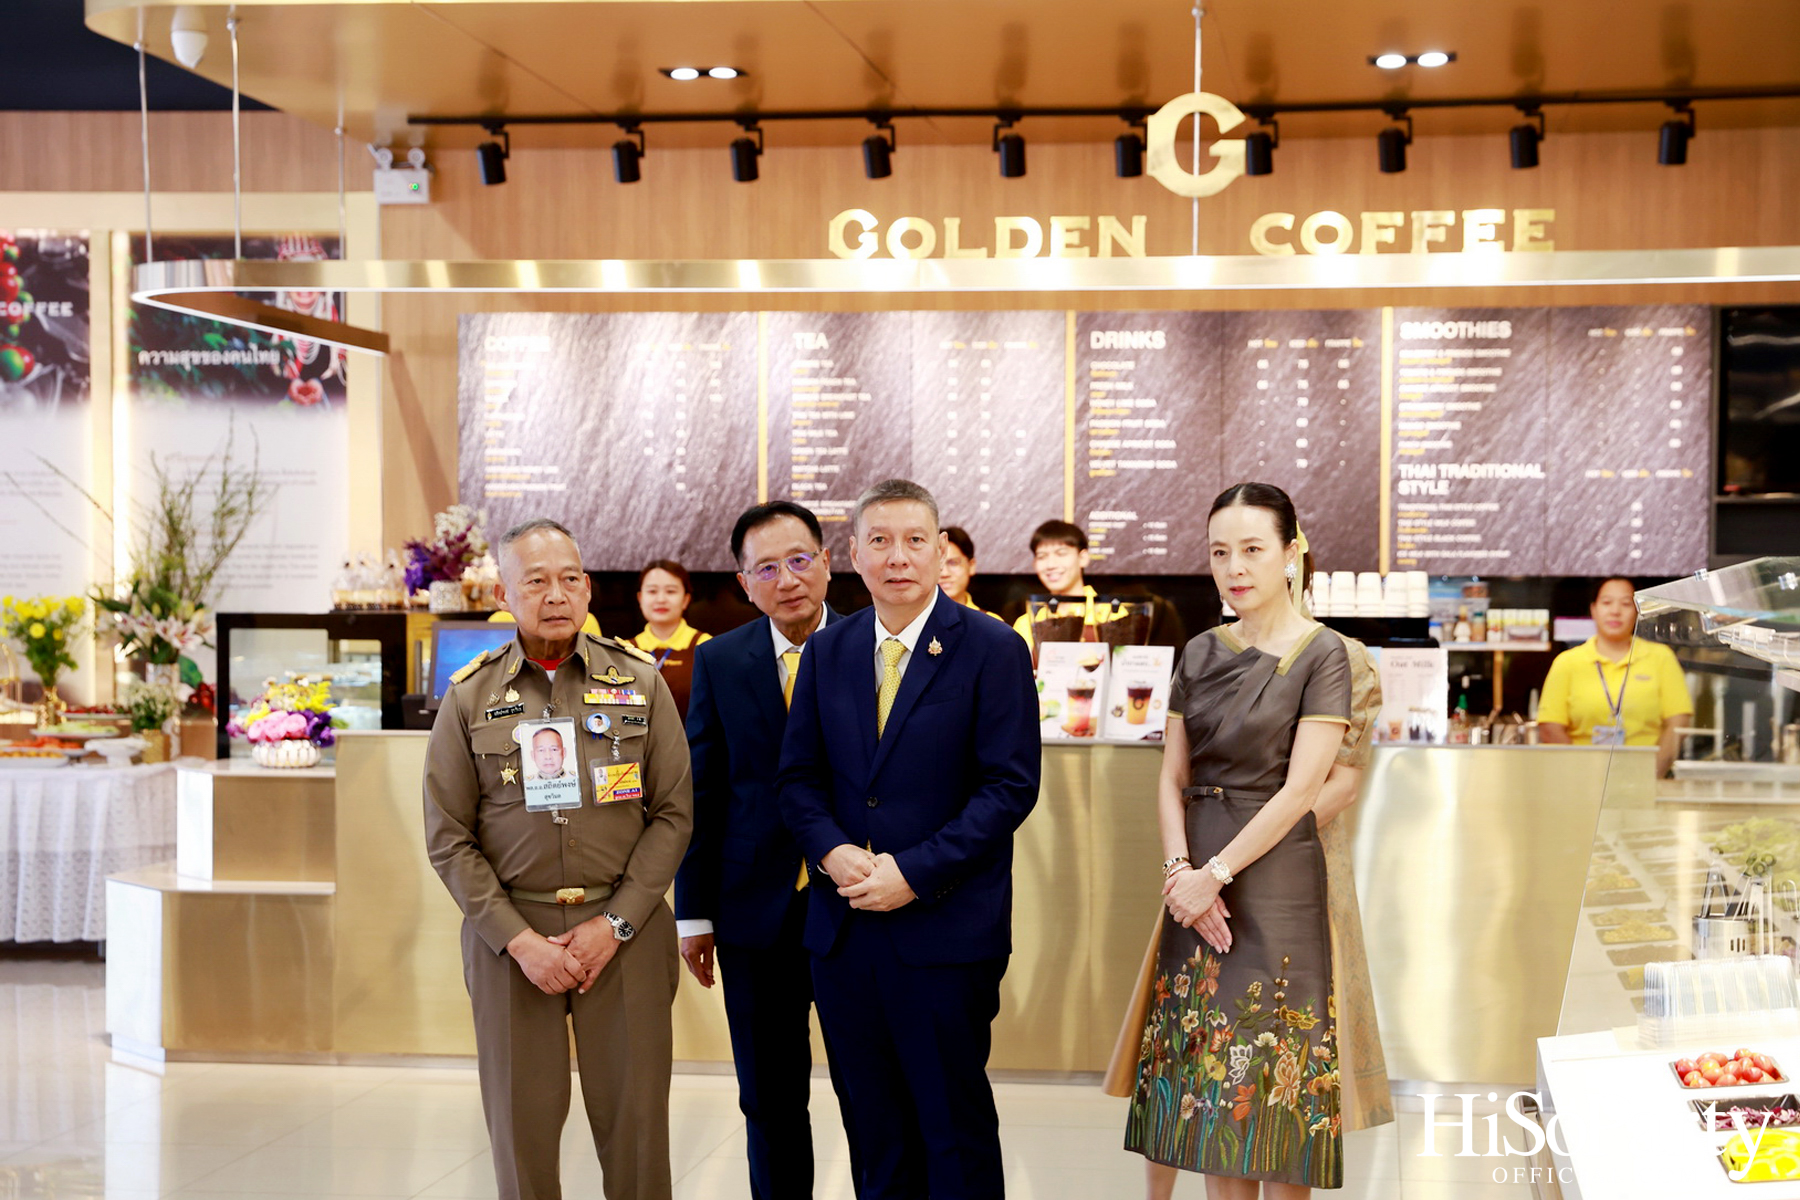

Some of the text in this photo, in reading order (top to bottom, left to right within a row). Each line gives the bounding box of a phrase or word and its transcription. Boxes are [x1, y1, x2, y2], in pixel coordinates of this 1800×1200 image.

[828, 208, 1556, 260] GOLDEN COFFEE
[1400, 321, 1512, 339] SMOOTHIES
[792, 332, 829, 350] TEA
[1090, 330, 1166, 349] DRINKS
[1398, 463, 1546, 479] THAI TRADITIONAL
[1398, 480, 1449, 495] STYLE
